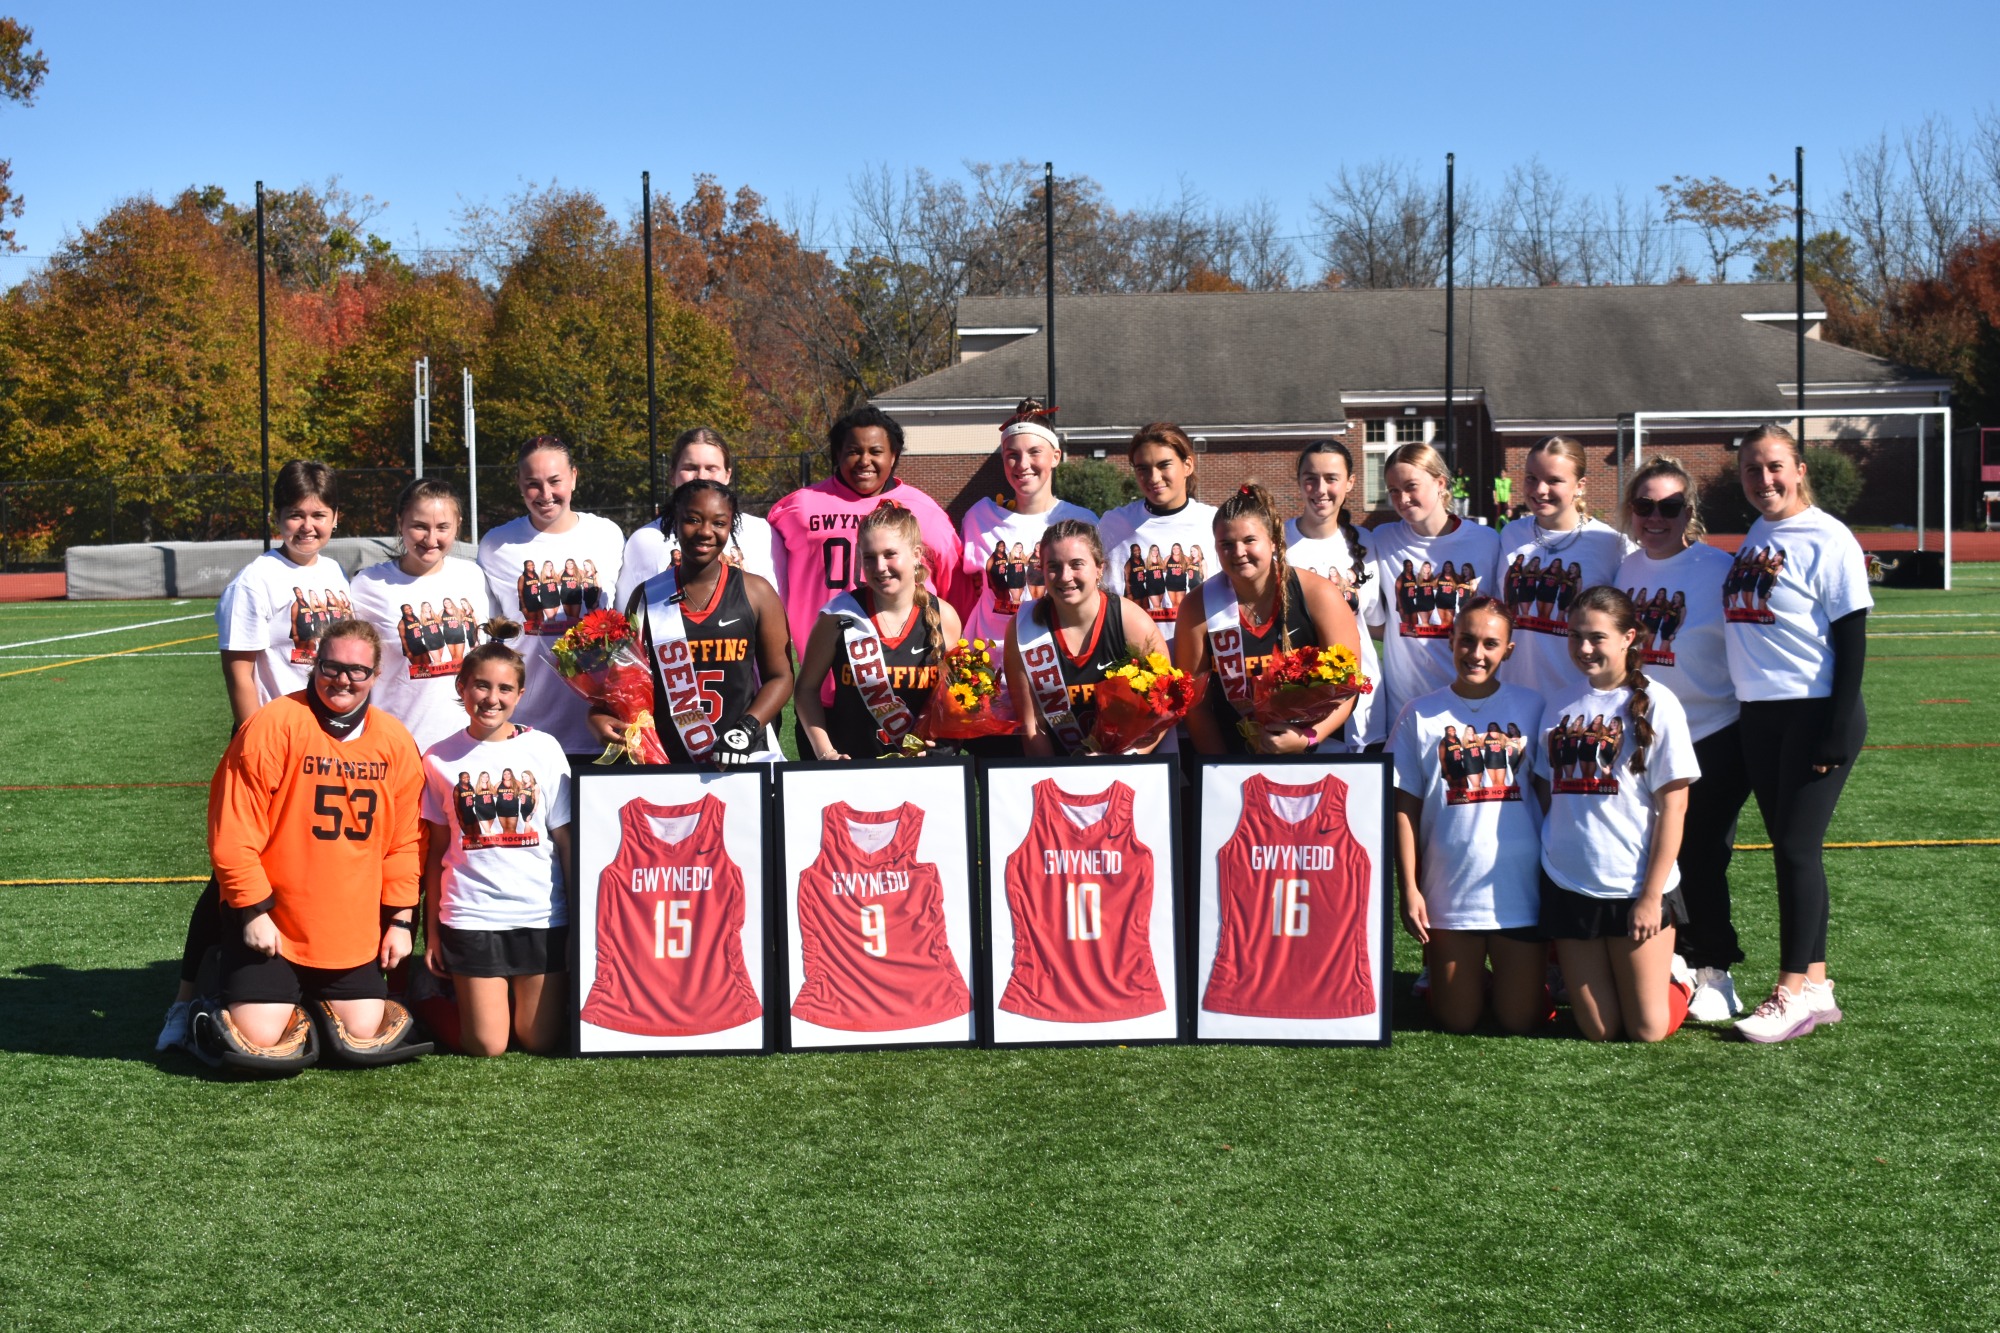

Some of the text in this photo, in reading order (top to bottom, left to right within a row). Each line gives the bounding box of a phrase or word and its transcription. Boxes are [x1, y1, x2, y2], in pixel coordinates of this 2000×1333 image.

[809, 514, 868, 532] GWYN
[302, 755, 389, 781] GWYNEDD
[312, 784, 378, 841] 53
[1043, 849, 1123, 875] GWYNEDD
[1251, 845, 1335, 871] GWYNEDD
[631, 866, 713, 893] GWYNEDD
[831, 870, 910, 898] GWYNEDD
[1065, 881, 1102, 941] 10
[1271, 878, 1310, 937] 16
[653, 899, 693, 959] 15
[859, 903, 887, 958] 9
